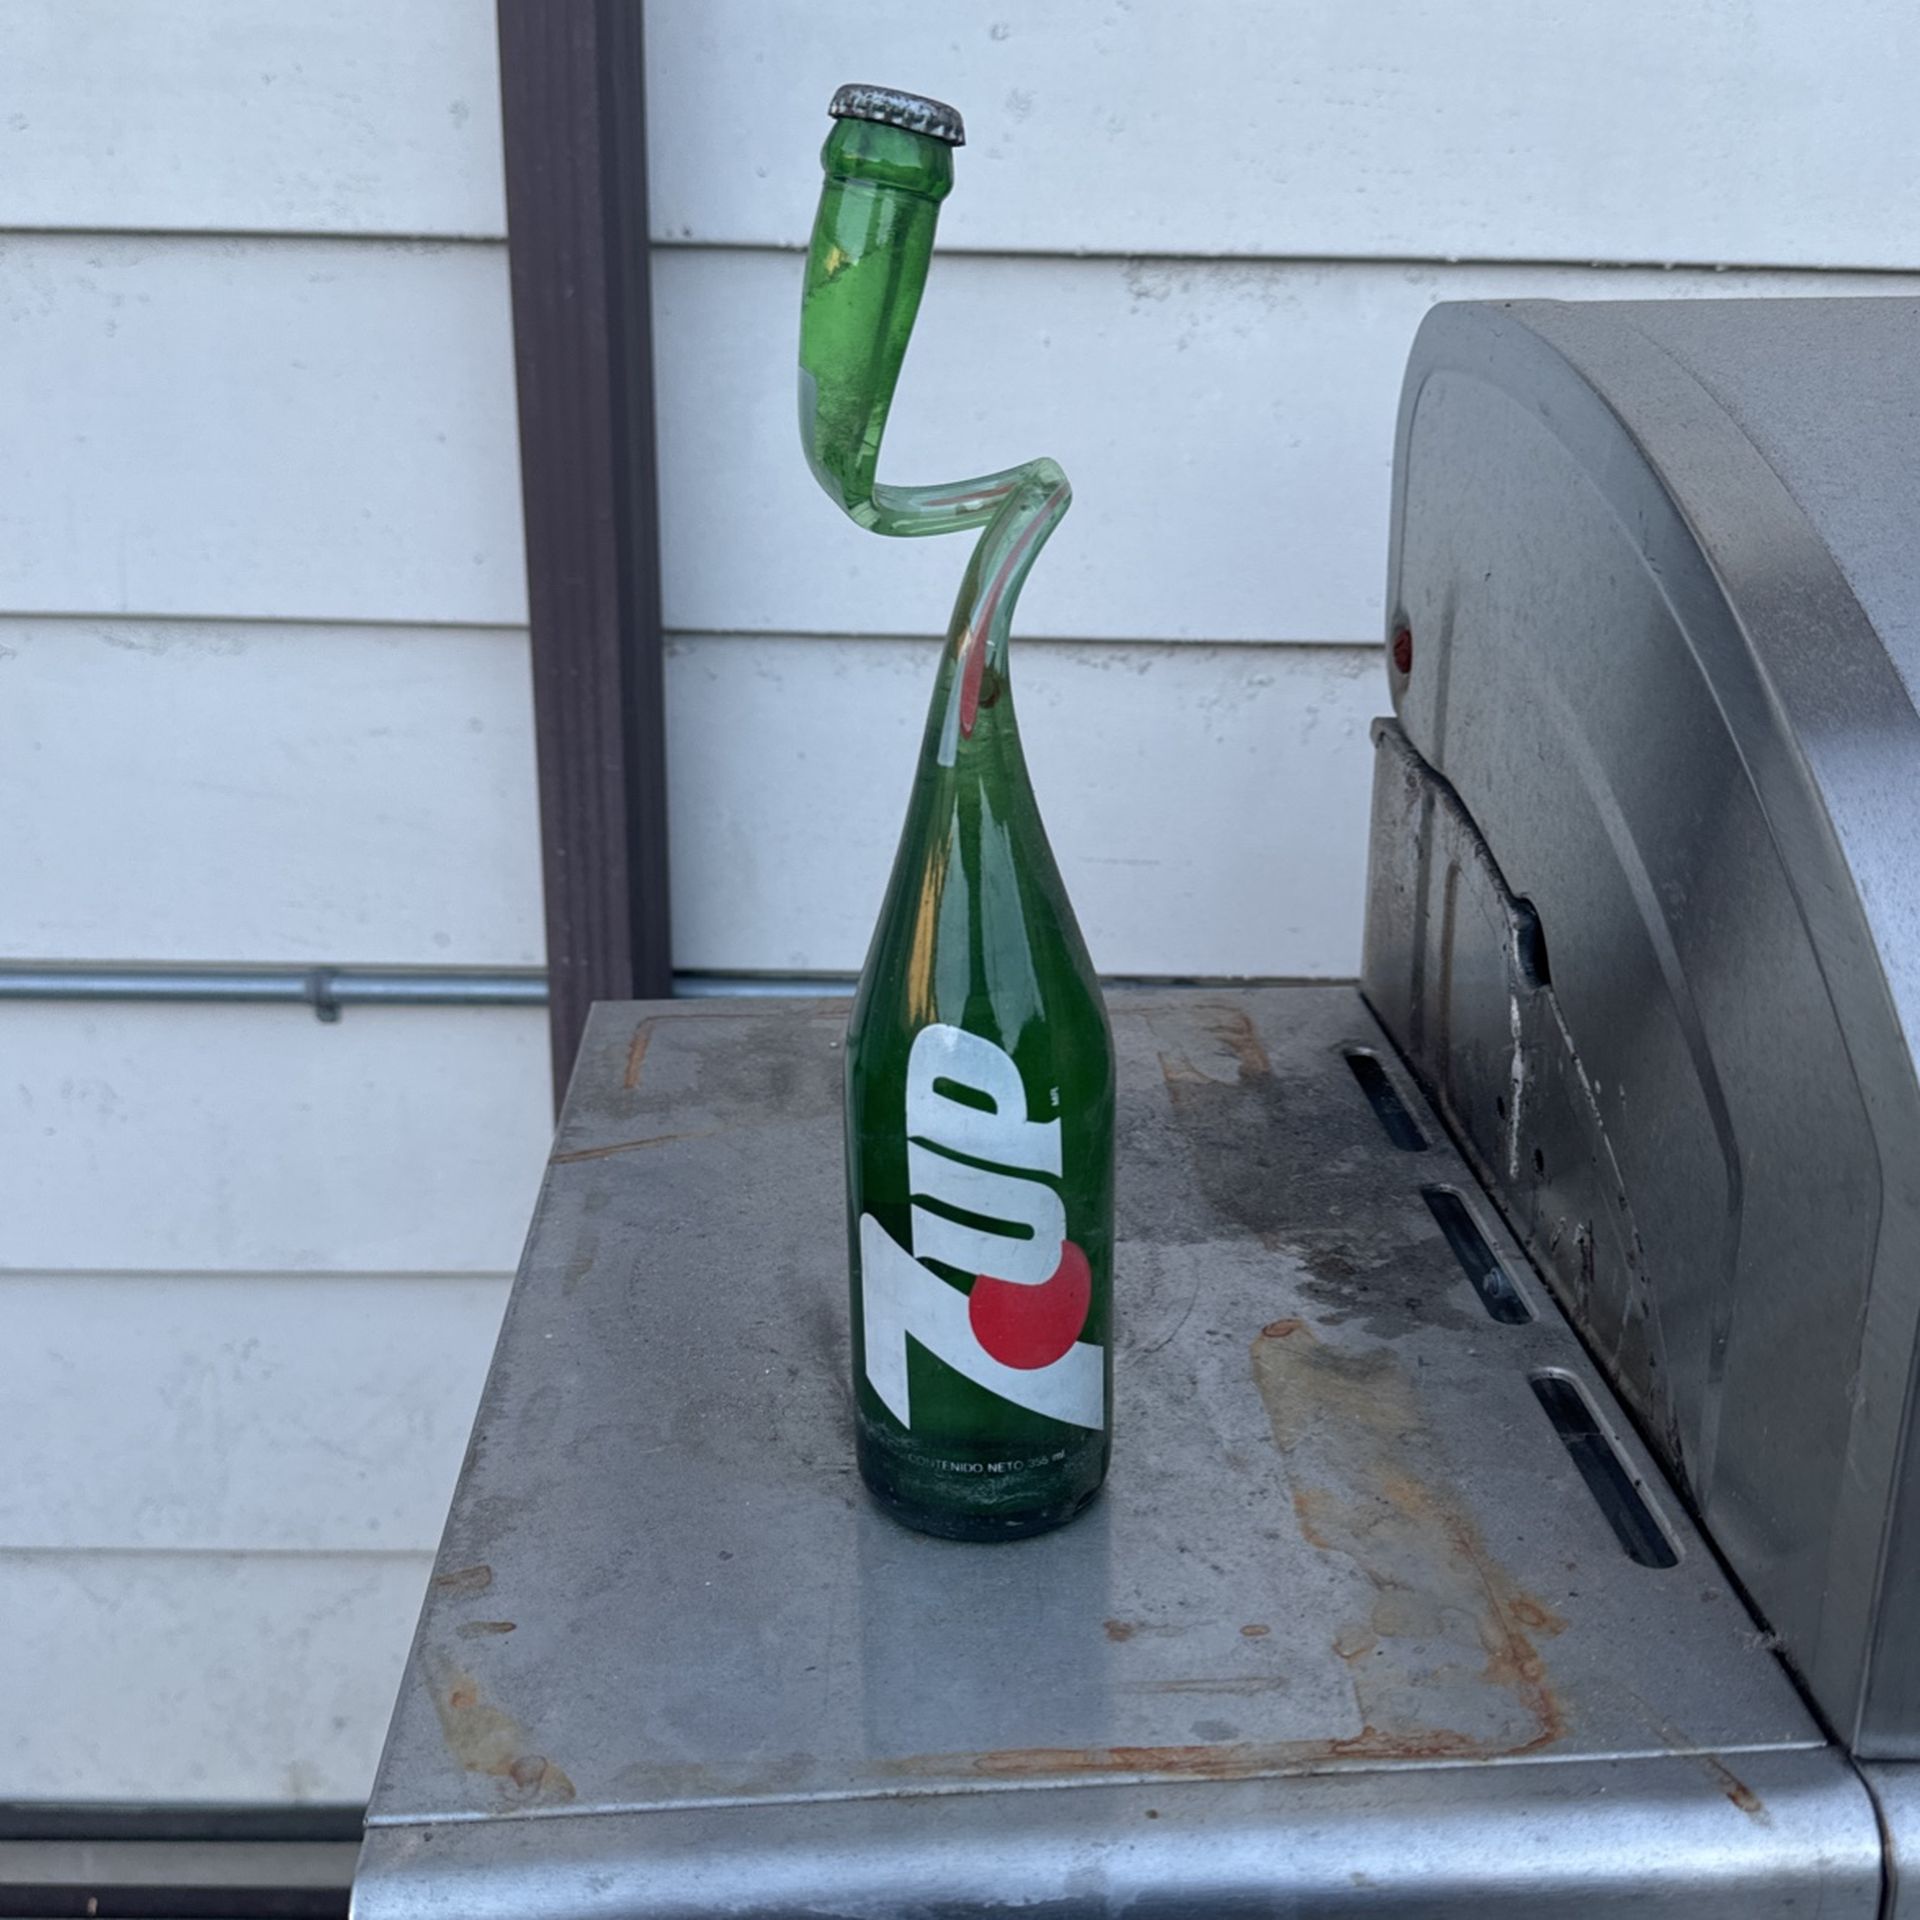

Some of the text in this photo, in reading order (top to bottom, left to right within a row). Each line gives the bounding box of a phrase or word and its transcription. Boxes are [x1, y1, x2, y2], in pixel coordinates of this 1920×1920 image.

[860, 1023, 1104, 1431] 7UP
[908, 1453, 983, 1473] CONTENIDO
[987, 1460, 1024, 1473] NETO
[1052, 1448, 1066, 1461] ml
